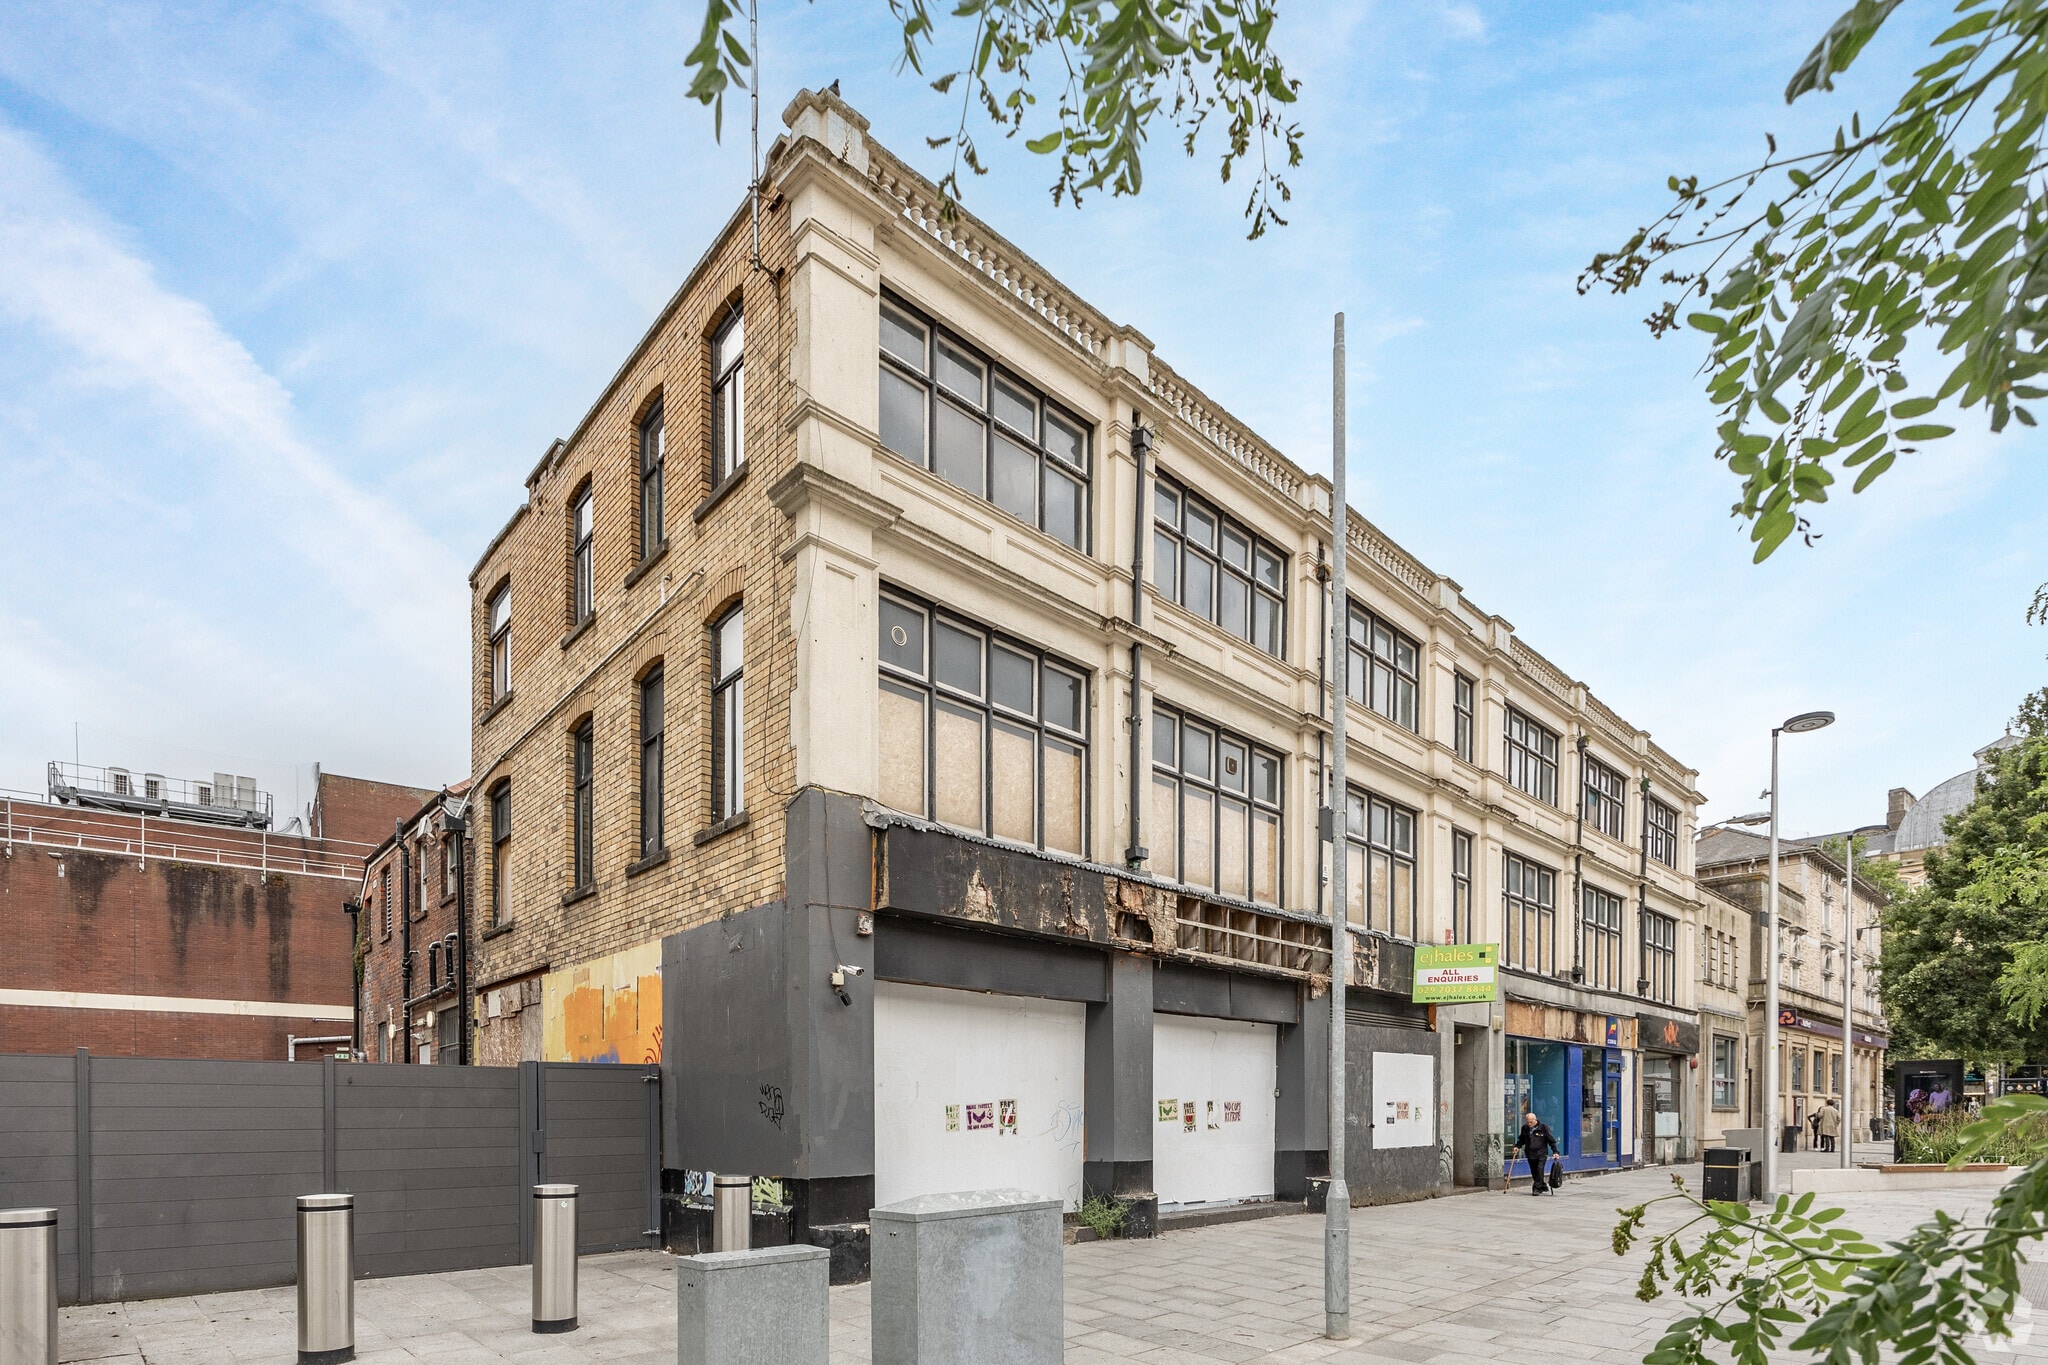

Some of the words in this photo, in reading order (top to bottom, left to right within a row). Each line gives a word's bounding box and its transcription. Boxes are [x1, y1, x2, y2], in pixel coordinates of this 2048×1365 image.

[1427, 975, 1479, 983] ENQUIRIES
[1417, 986, 1436, 994] 029
[1439, 985, 1463, 993] 2037
[1466, 985, 1492, 993] 8844
